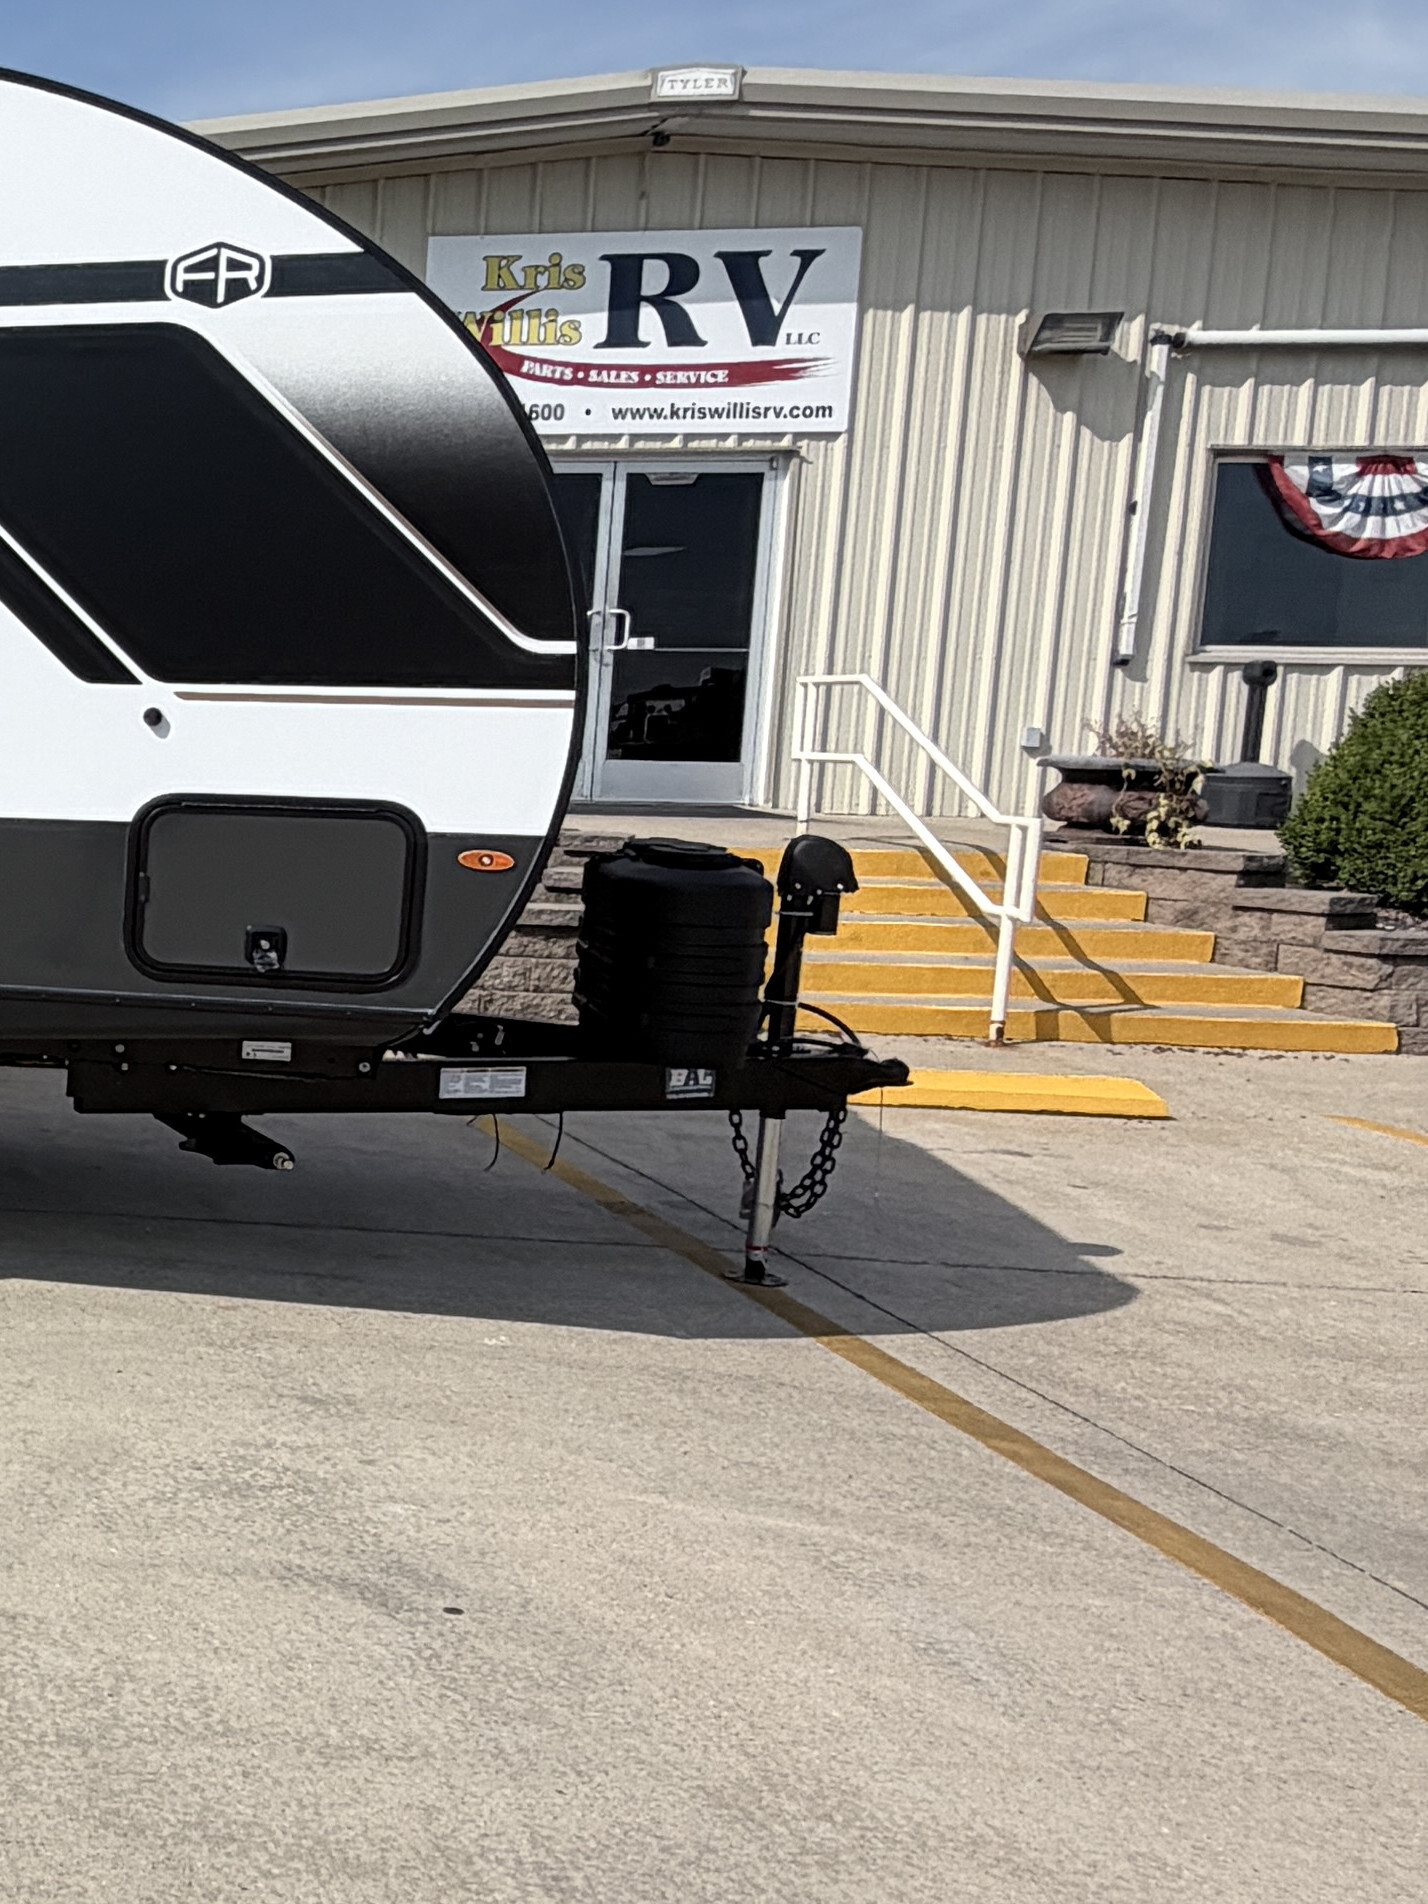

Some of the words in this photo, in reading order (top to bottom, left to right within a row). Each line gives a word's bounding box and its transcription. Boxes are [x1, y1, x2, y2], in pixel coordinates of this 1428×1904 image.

[666, 77, 730, 91] TYLER
[481, 252, 586, 291] Kris
[593, 249, 826, 349] RV
[785, 332, 820, 345] LLC
[520, 359, 573, 381] PARTS
[588, 370, 639, 384] SALES
[655, 370, 729, 384] SERVICE
[522, 403, 565, 421] 600
[611, 401, 833, 420] www.kriswillisrv.com
